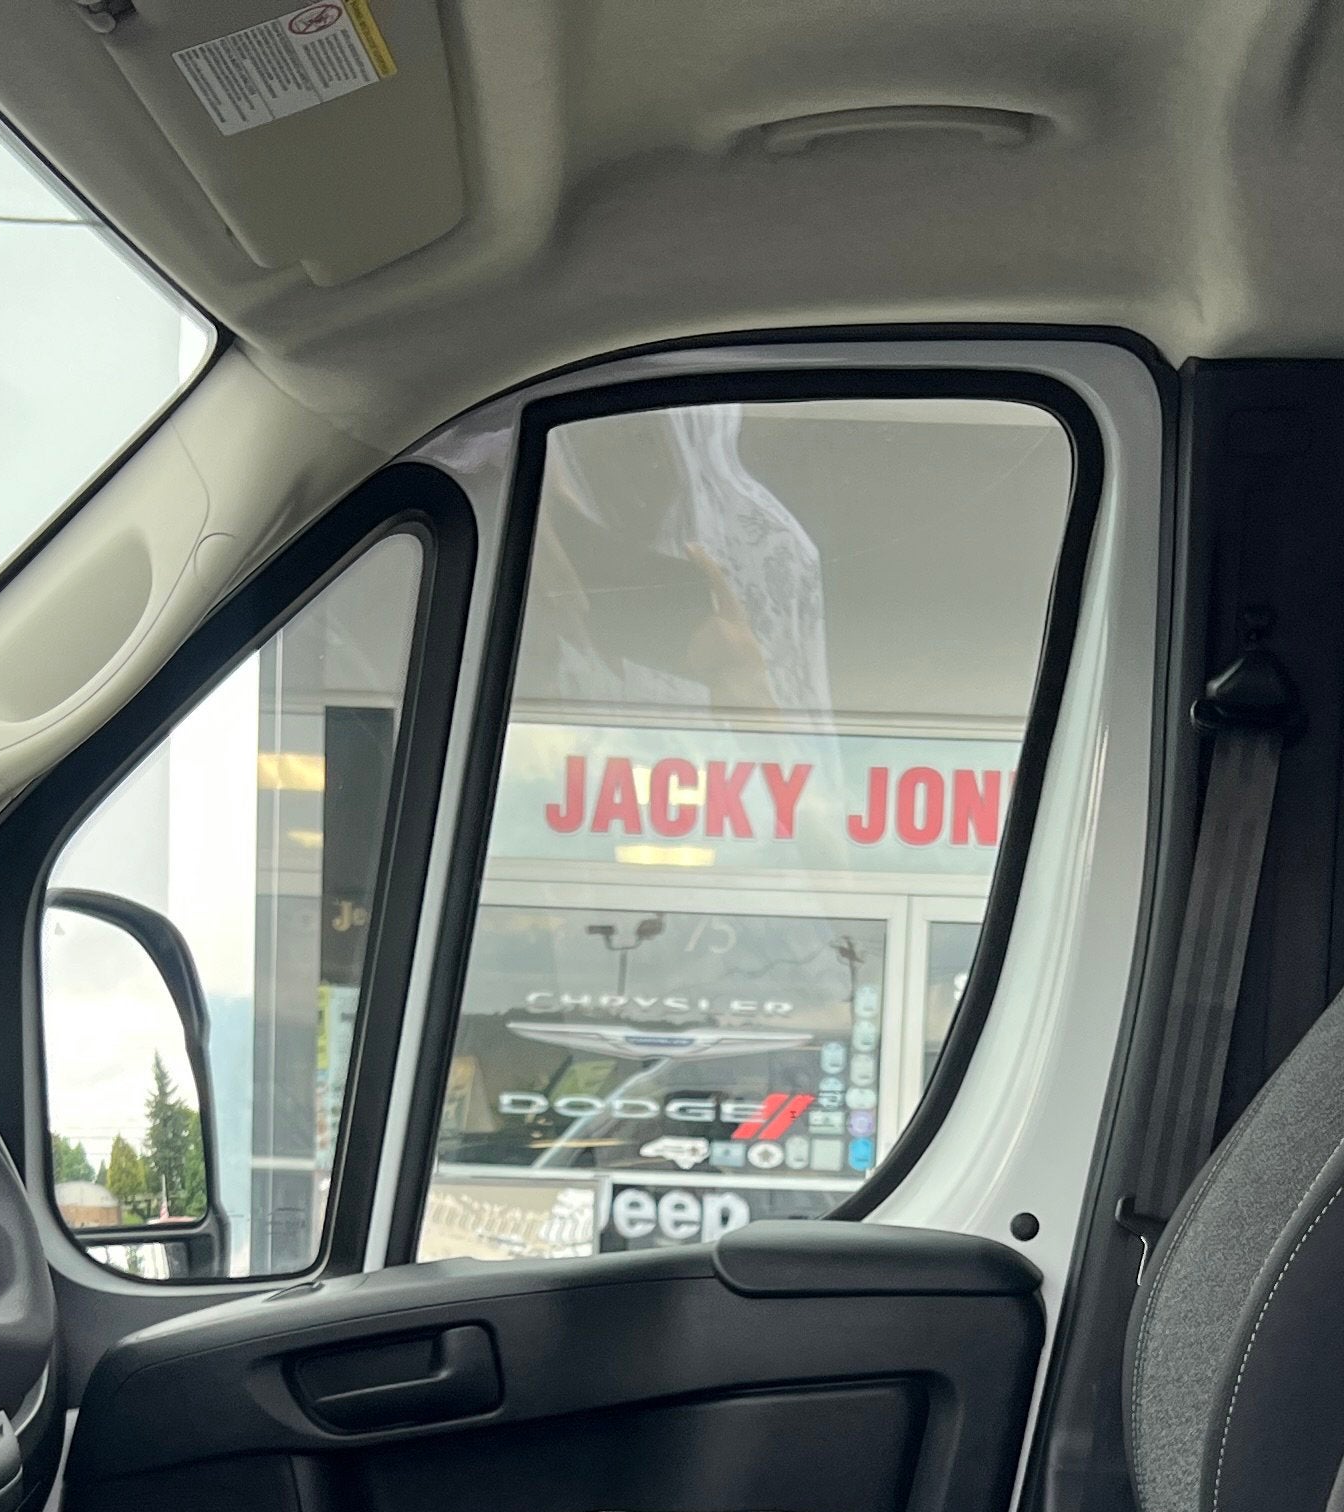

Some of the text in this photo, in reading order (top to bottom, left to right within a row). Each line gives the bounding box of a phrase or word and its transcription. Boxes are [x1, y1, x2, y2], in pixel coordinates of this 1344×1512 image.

[545, 754, 1018, 847] JACKY JON
[525, 991, 795, 1015] CHRYSLER
[499, 1092, 768, 1123] DODGE
